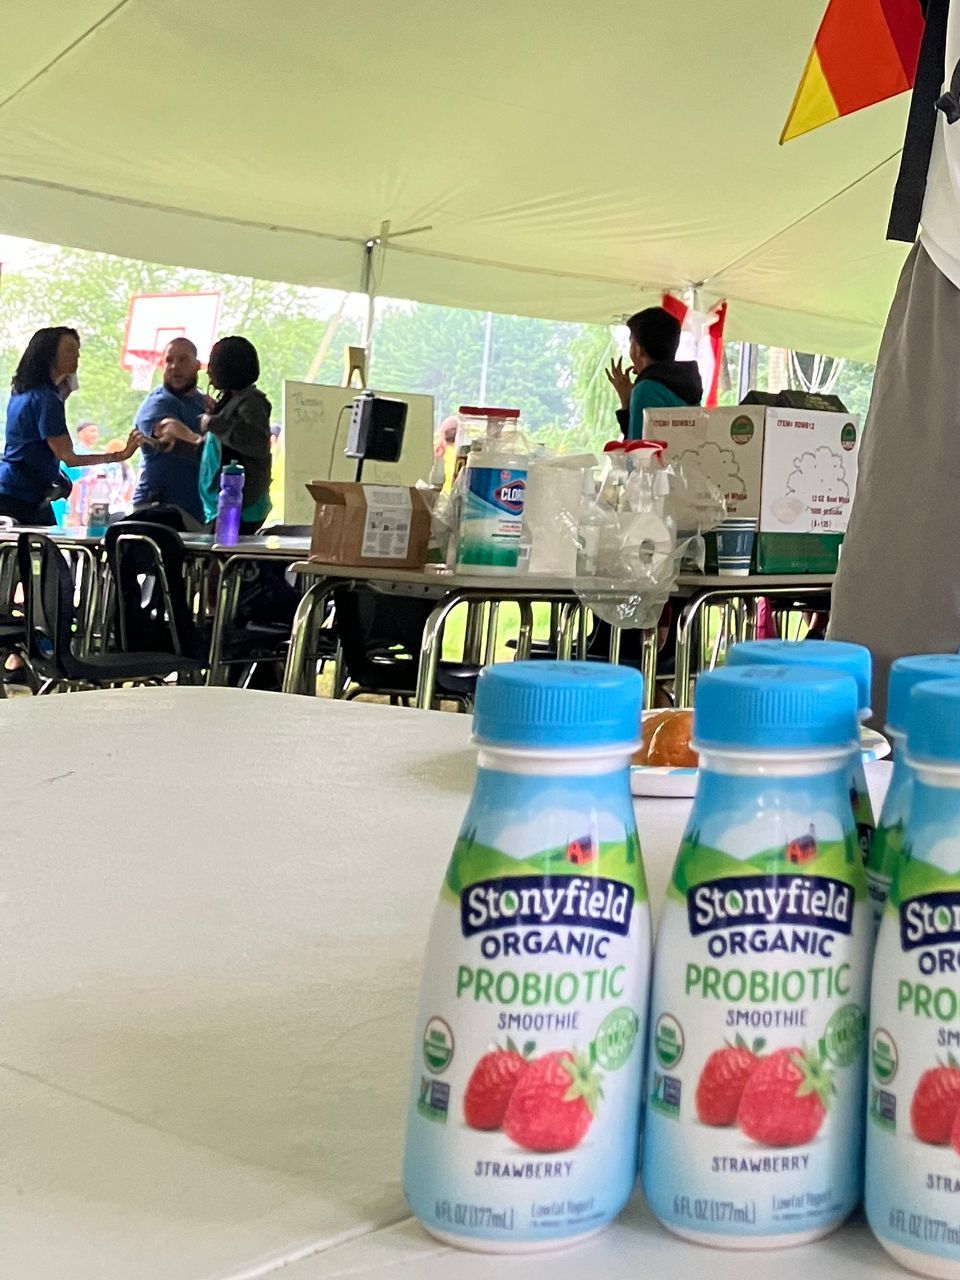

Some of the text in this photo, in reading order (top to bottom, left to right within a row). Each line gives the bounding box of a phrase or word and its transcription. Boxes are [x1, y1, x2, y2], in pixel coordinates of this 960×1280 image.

[467, 881, 630, 926] Stonyfield
[694, 881, 851, 925] Stonyfield
[481, 931, 610, 960] ORGANIC
[708, 930, 834, 958] ORGANIC
[456, 965, 627, 1006] PROBIOTIC
[685, 962, 851, 1003] PROBIOTIC
[497, 1011, 581, 1030] SMOOTHIE
[726, 1009, 807, 1027] SMOOTHIE
[474, 1160, 573, 1177] STRAWBERRY
[711, 1155, 809, 1173] STRAWBERRY
